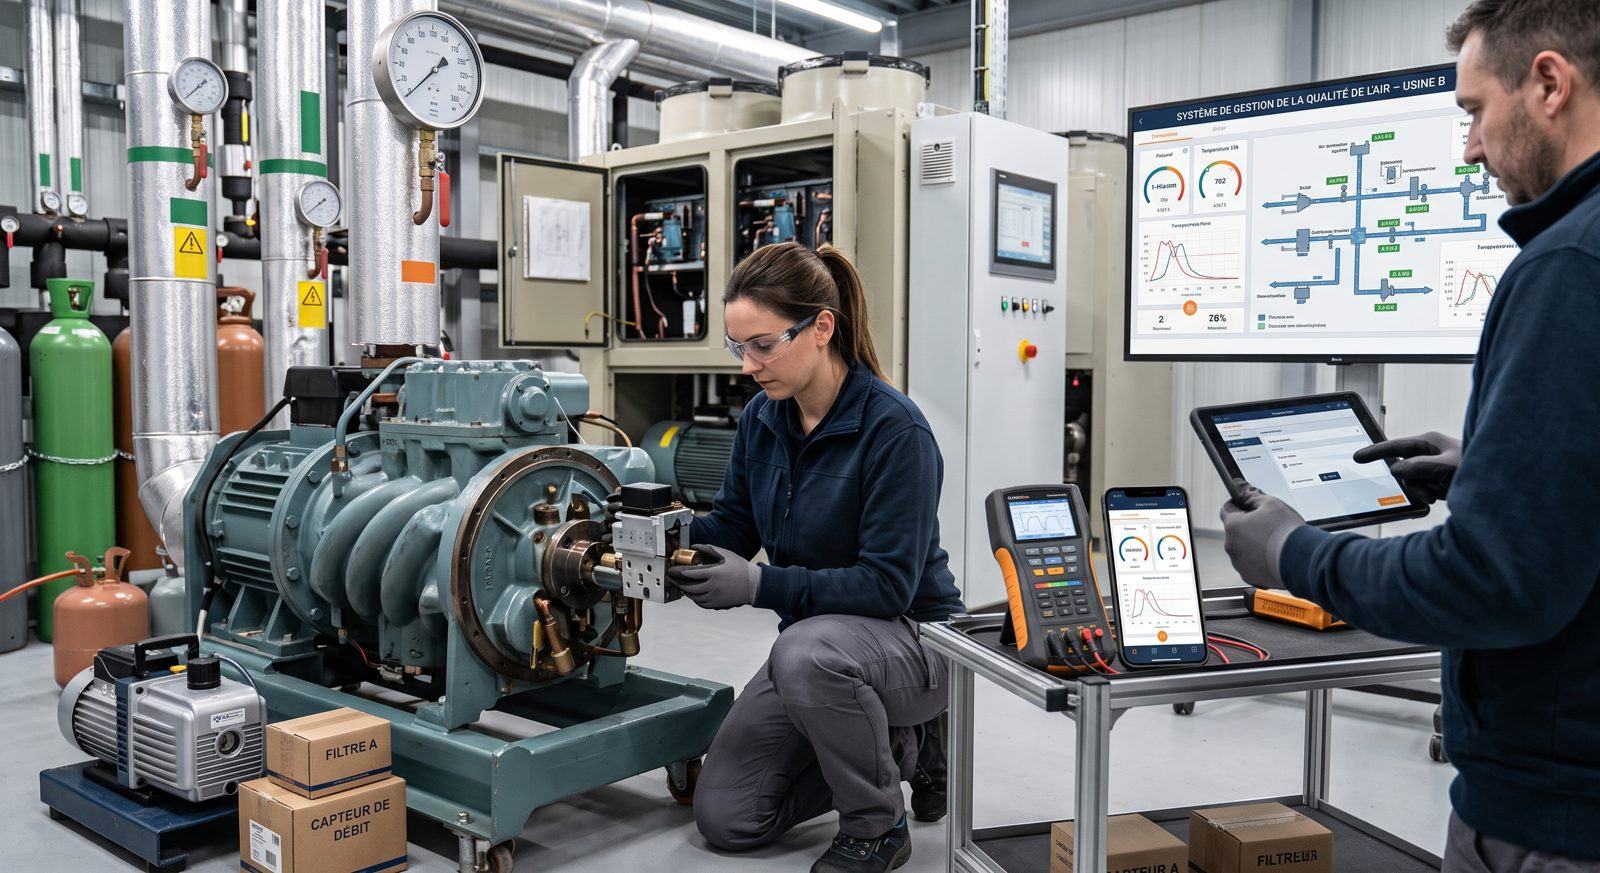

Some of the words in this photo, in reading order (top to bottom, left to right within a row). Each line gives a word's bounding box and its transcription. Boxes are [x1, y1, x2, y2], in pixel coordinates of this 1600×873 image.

[1220, 106, 1232, 115] DE
[1234, 100, 1274, 114] GESTION
[1277, 97, 1289, 108] DE
[1291, 96, 1303, 106] LA
[1306, 87, 1349, 104] QUALITÉ
[1351, 87, 1365, 97] DE
[1403, 78, 1435, 91] USINE
[1438, 76, 1446, 86] B
[1158, 315, 1164, 323] 2
[326, 741, 366, 760] FILTRE
[369, 739, 378, 750] A
[311, 805, 370, 830] CAPTEUR
[374, 799, 390, 814] DE
[334, 821, 371, 842] DÉBIT
[1170, 863, 1179, 873] A
